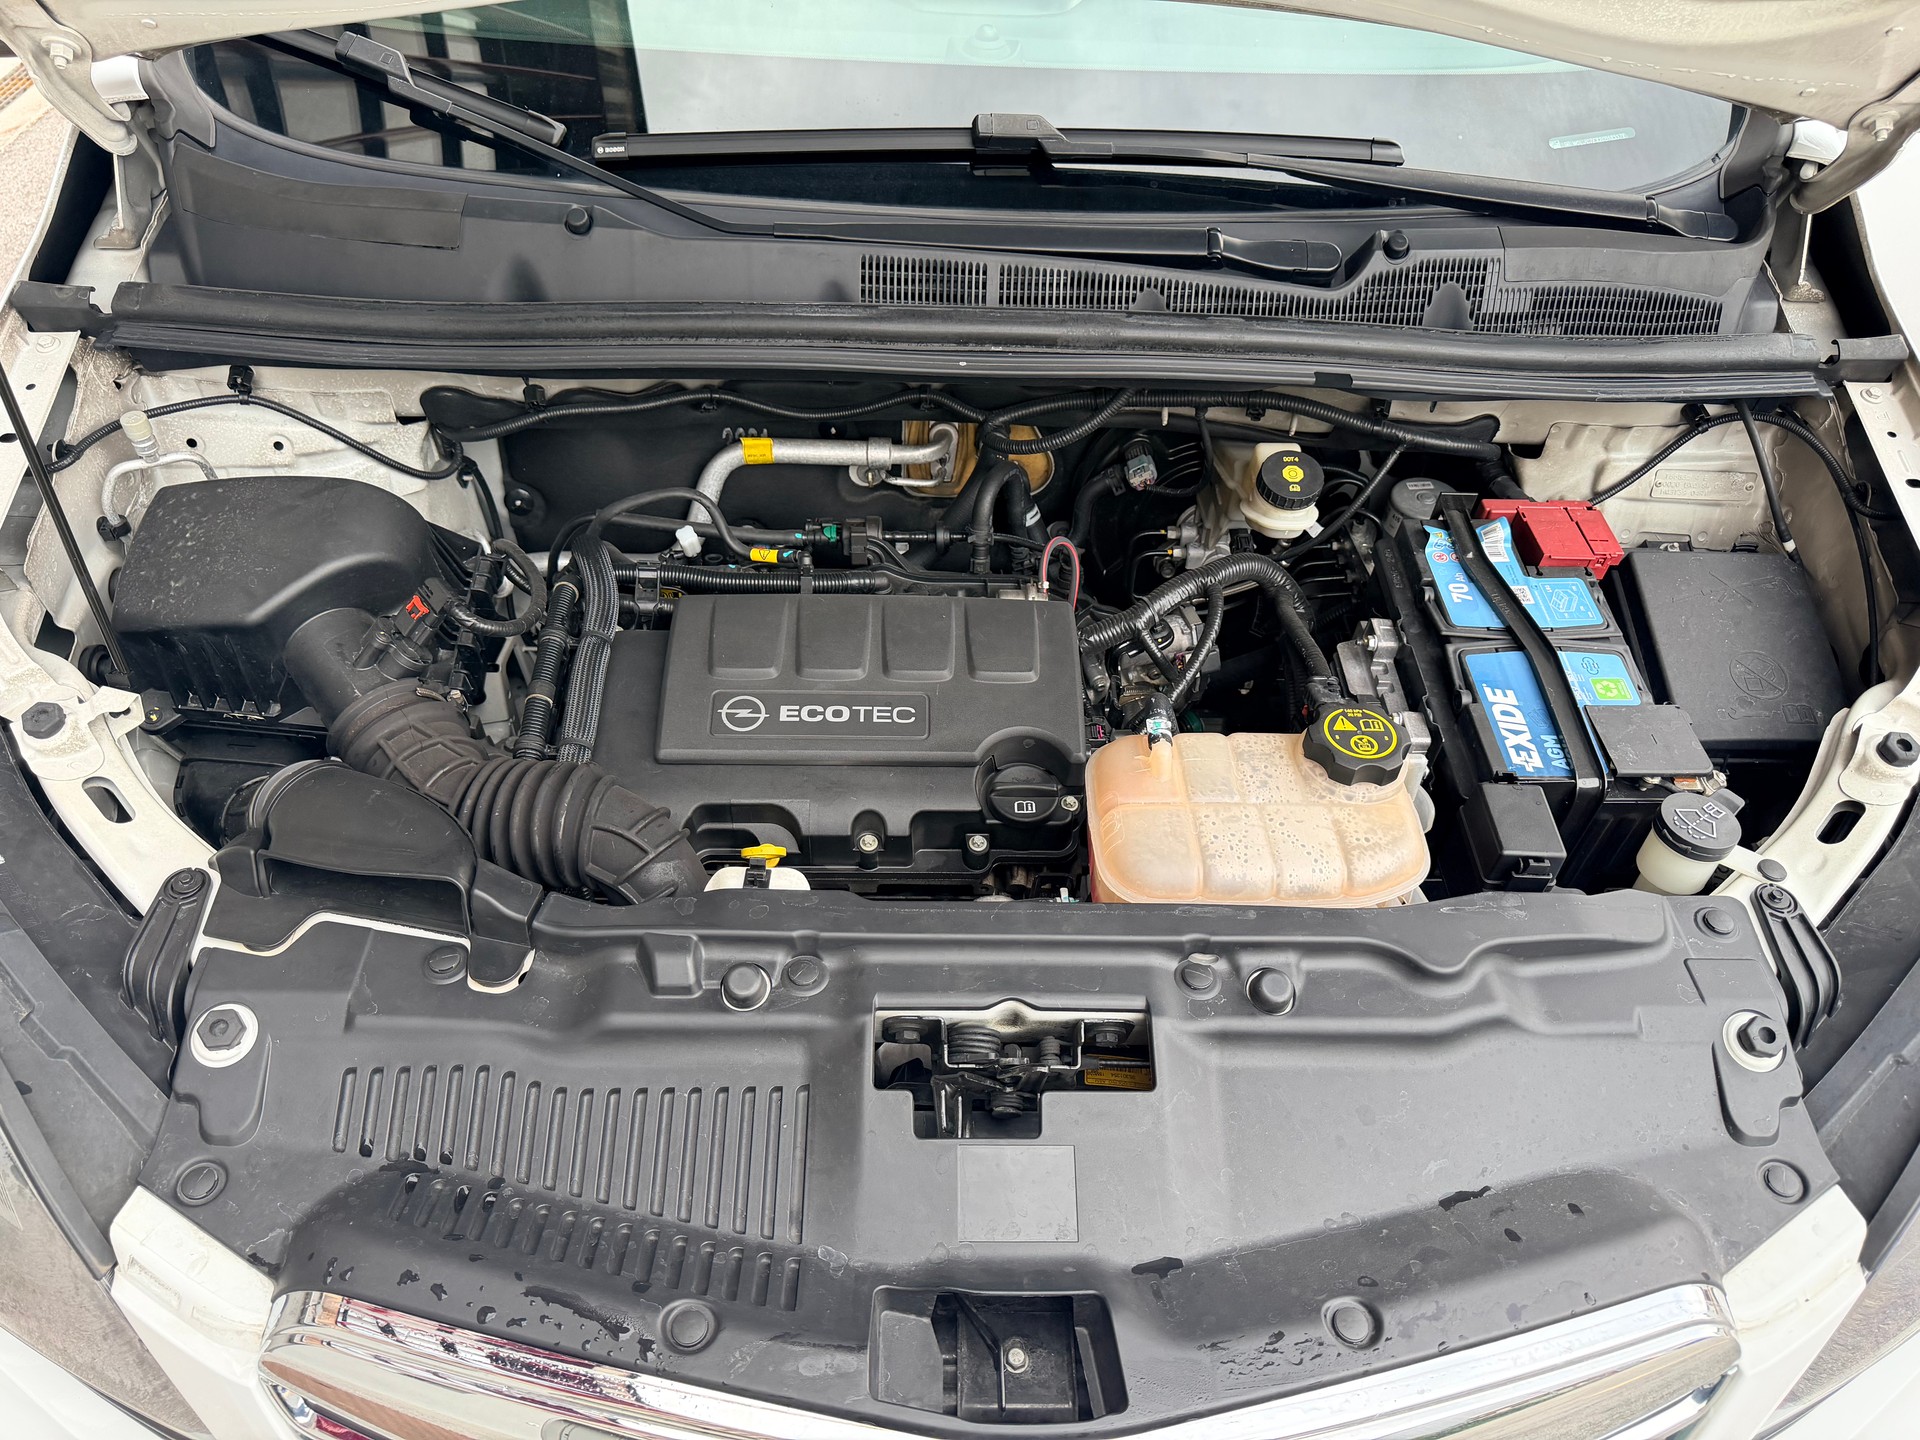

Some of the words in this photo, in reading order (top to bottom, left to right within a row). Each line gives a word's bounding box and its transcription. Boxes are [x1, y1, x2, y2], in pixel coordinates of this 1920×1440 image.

[1454, 572, 1466, 582] Ah
[1449, 583, 1473, 602] 70
[779, 705, 916, 723] ECOTEC
[1483, 686, 1544, 772] EXIDE
[1541, 735, 1570, 769] AGM
